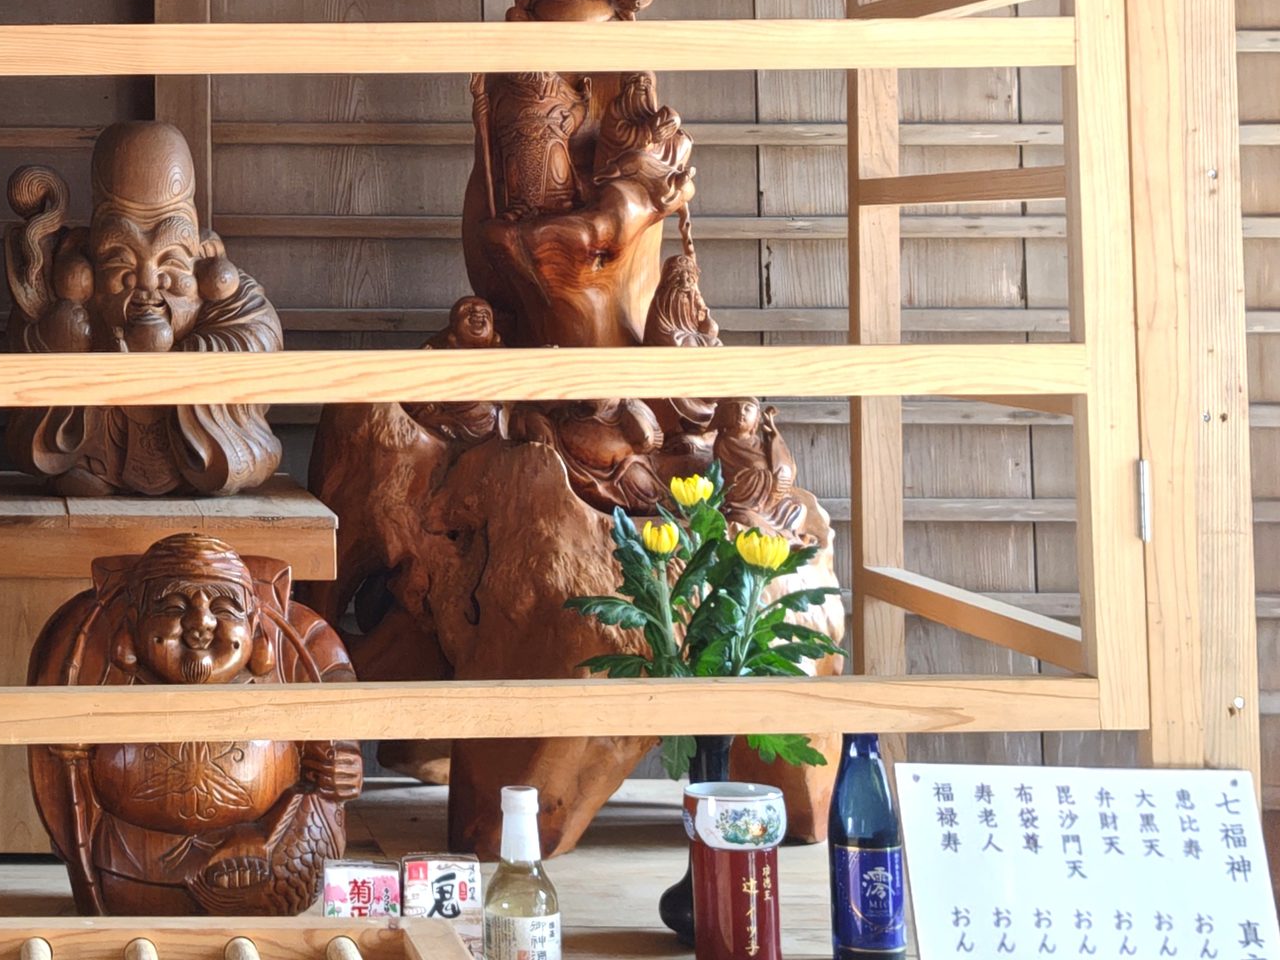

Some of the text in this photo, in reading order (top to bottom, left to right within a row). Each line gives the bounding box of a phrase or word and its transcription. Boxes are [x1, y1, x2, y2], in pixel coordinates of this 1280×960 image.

[932, 782, 975, 953] 福禄寿 おん
[973, 782, 1016, 954] 寿老人 おん
[1013, 783, 1057, 954] 布袋尊 おん
[1055, 785, 1097, 955] 毘沙門天 おん
[1095, 786, 1138, 956] 弁財天 おん
[1134, 788, 1178, 957] 大黒天 おん
[1175, 788, 1219, 959] 恵比寿 おん
[1215, 791, 1267, 960] 七福神 真
